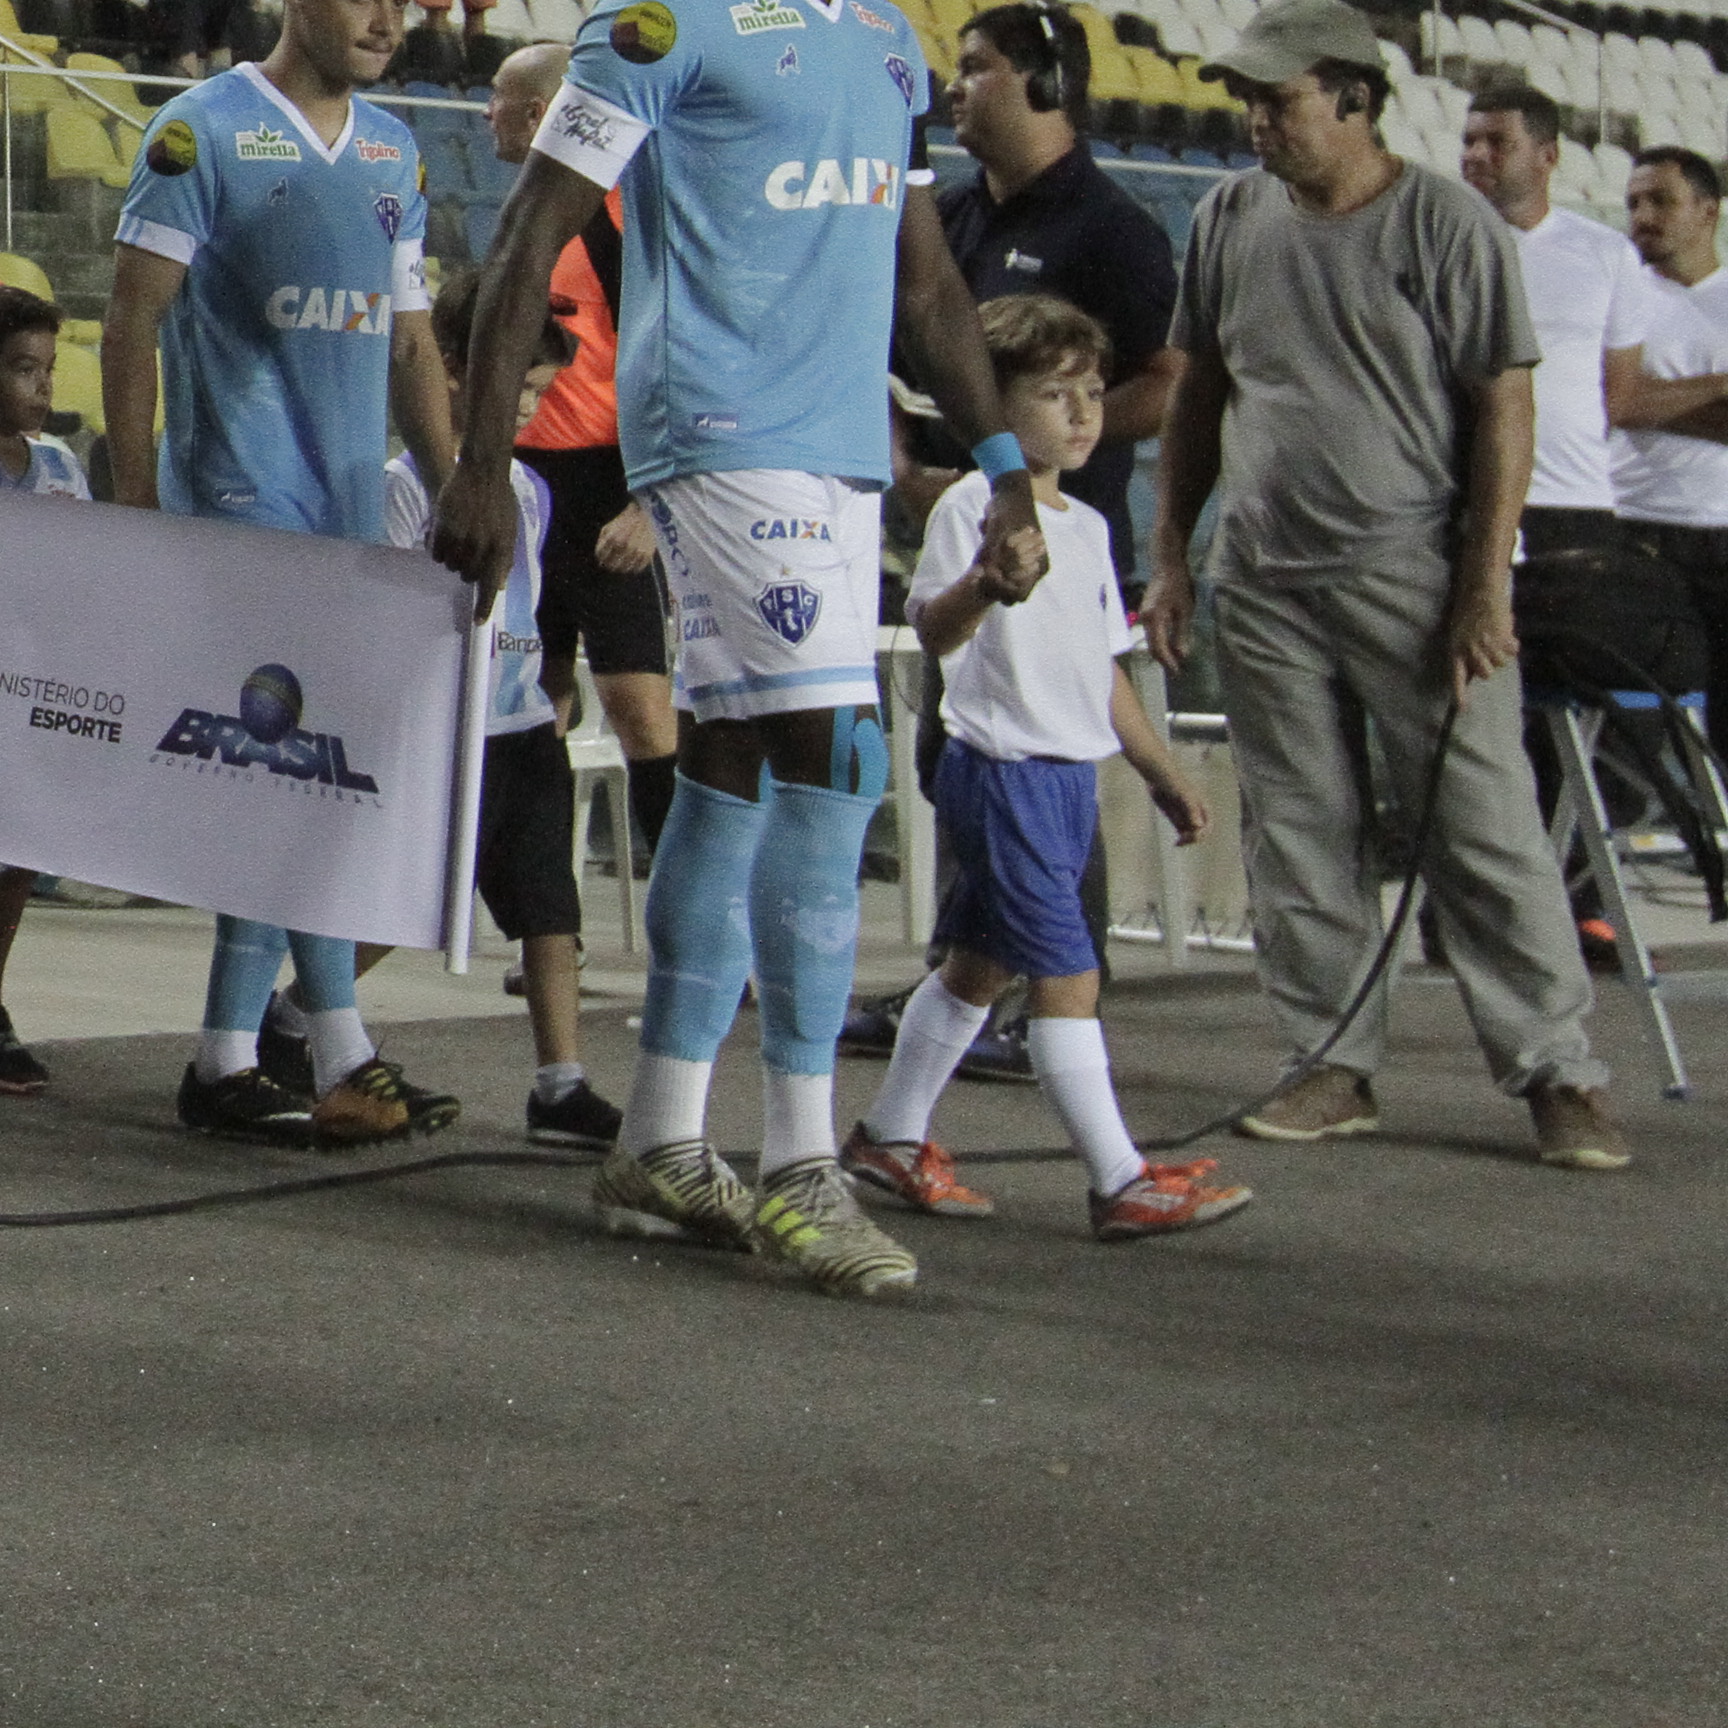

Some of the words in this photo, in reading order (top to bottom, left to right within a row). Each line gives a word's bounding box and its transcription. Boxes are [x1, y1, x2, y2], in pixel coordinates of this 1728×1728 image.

[738, 10, 800, 32] mirella
[240, 141, 297, 157] mirella
[355, 139, 399, 160] Trigolino
[750, 518, 831, 543] CAIXA
[94, 691, 125, 716] DO
[29, 706, 123, 744] ESPORTE
[155, 708, 380, 794] BRASIL
[149, 753, 256, 785] GOVERNO
